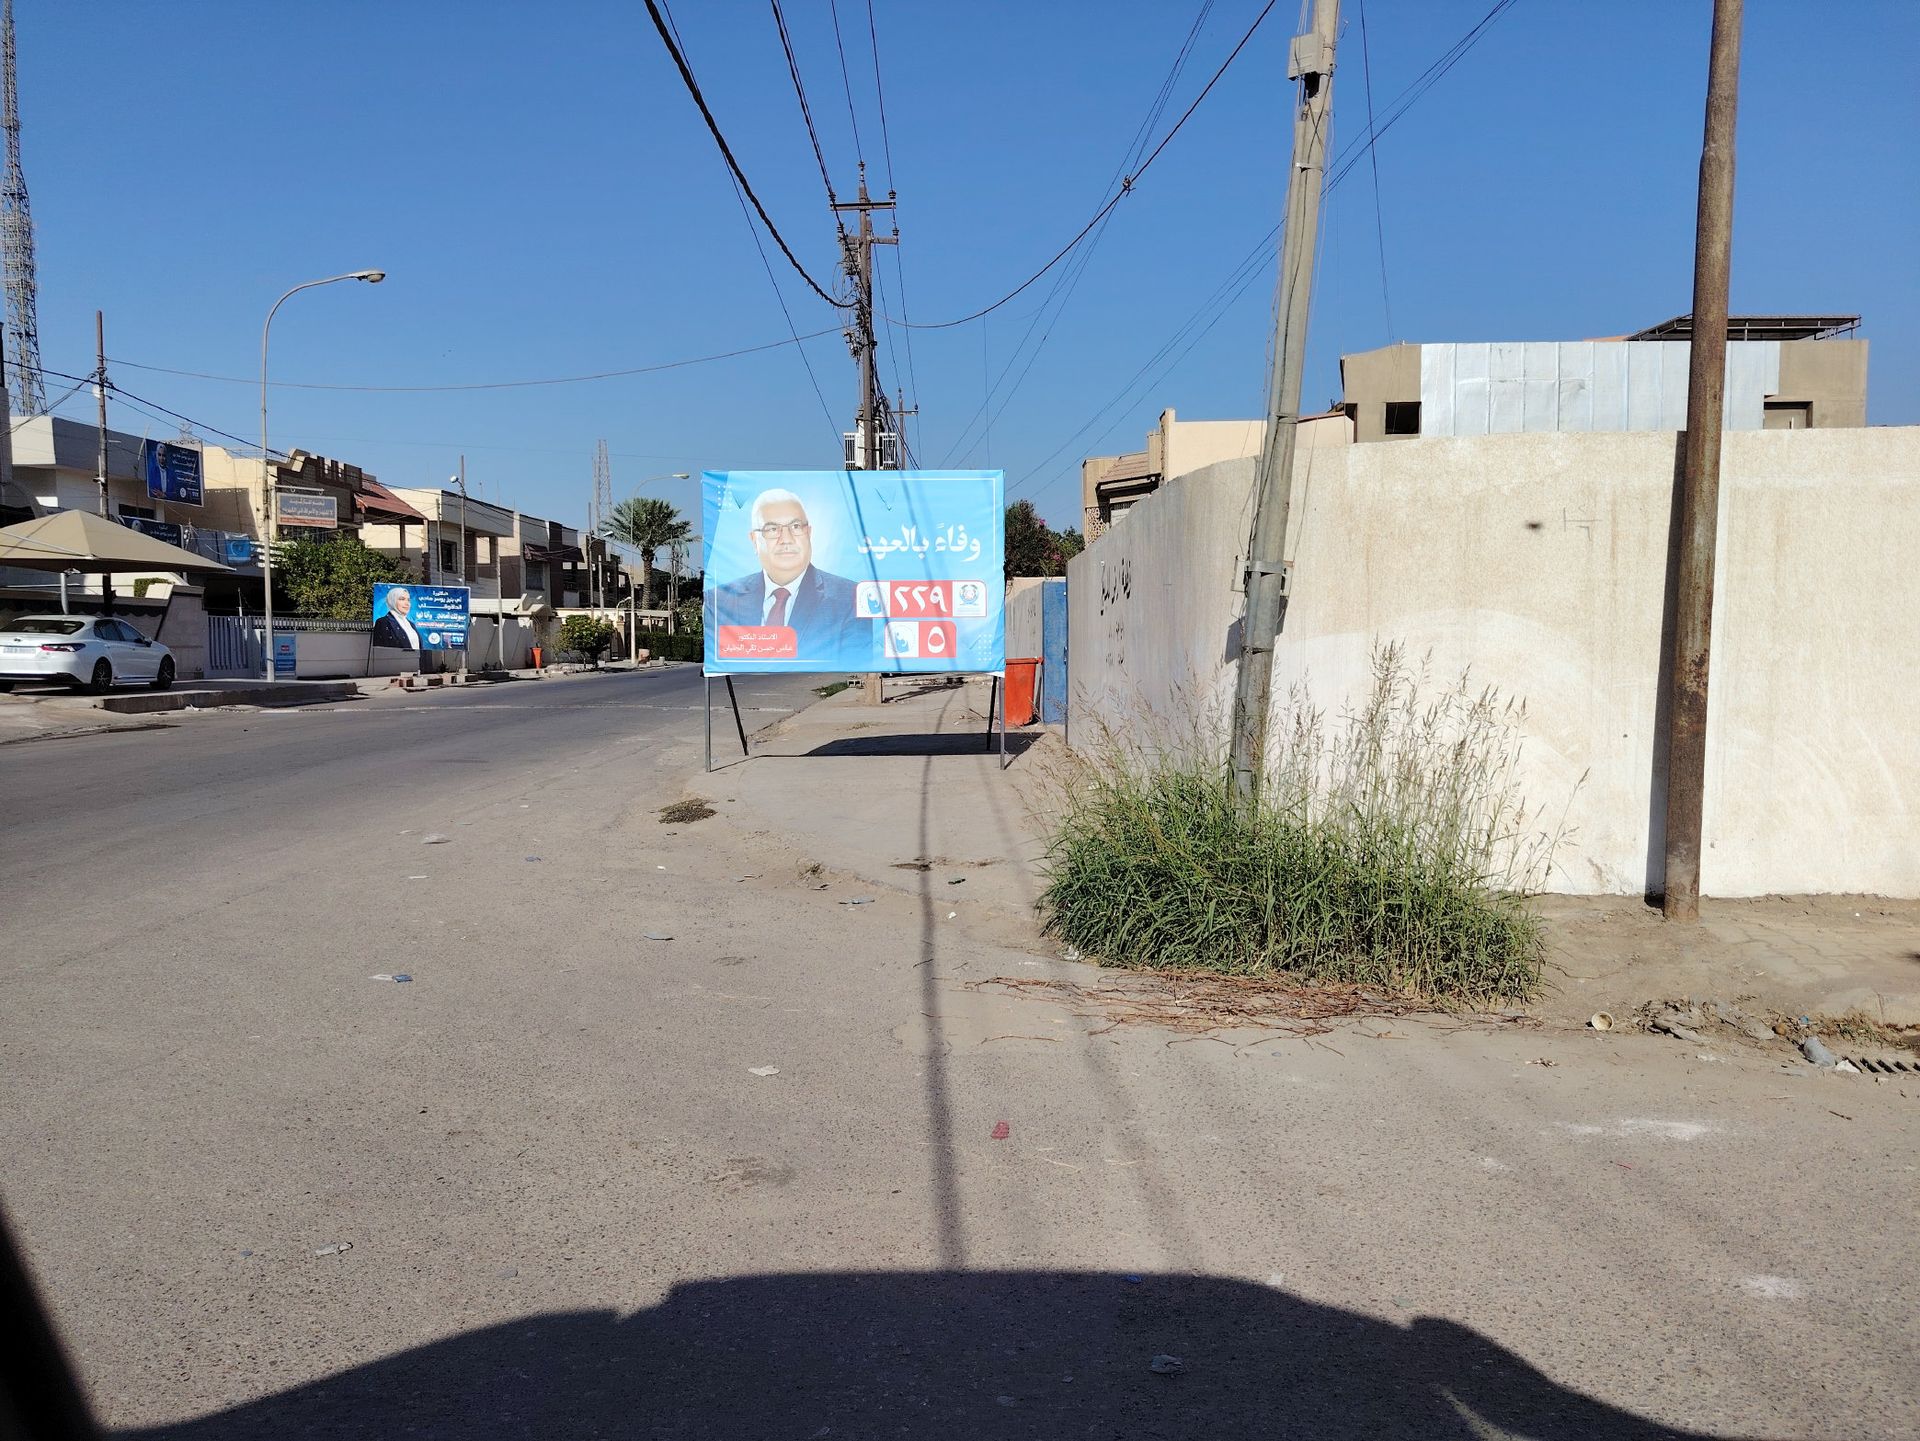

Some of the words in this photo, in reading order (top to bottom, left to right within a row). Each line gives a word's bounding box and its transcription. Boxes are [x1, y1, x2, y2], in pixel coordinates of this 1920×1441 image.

[857, 523, 930, 560] بالعهد
[894, 585, 948, 613] ٢٢٩
[927, 625, 946, 654] ٥
